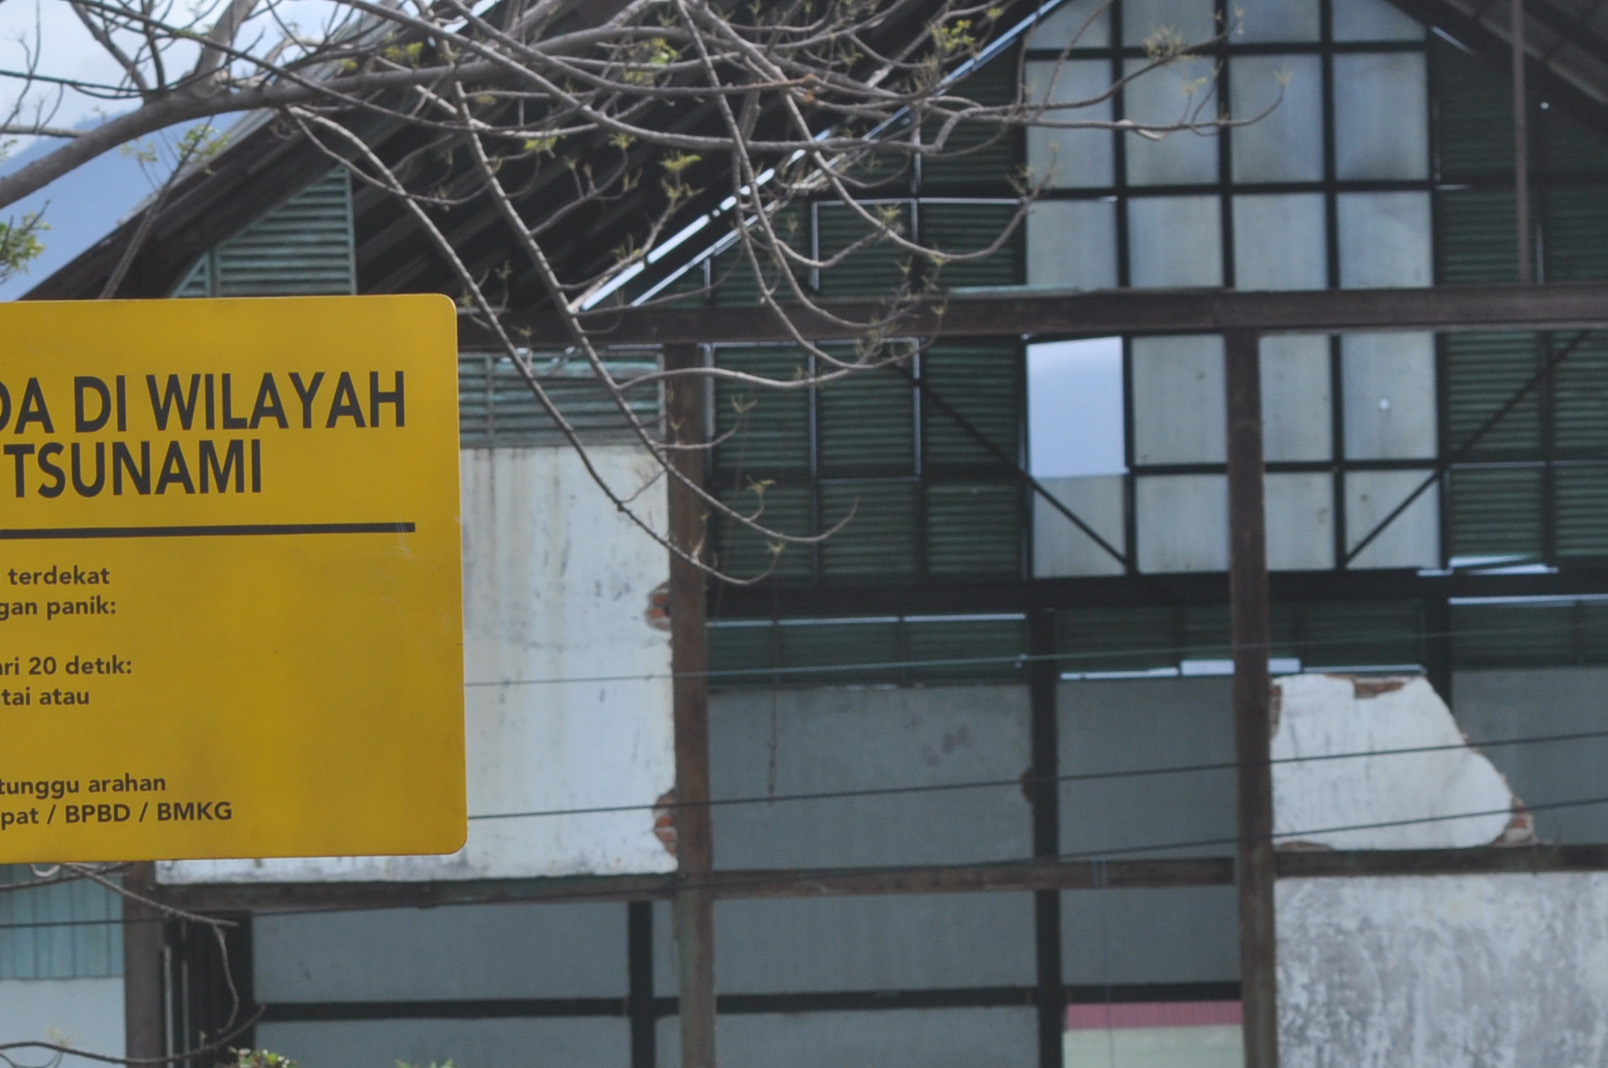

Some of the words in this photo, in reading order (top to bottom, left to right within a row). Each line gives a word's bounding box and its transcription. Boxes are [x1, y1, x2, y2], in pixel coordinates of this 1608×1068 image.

[73, 375, 127, 433] DI
[145, 370, 405, 431] WILAYAH
[3, 438, 262, 499] TSUNAMI
[7, 564, 110, 586] terdekat
[46, 594, 116, 621] panik:
[28, 656, 57, 676] 20
[39, 688, 90, 706] atau
[88, 772, 166, 793] arahan
[46, 804, 57, 825] /
[65, 803, 131, 824] BPBD
[138, 801, 149, 823] /
[157, 800, 233, 822] BMKG
